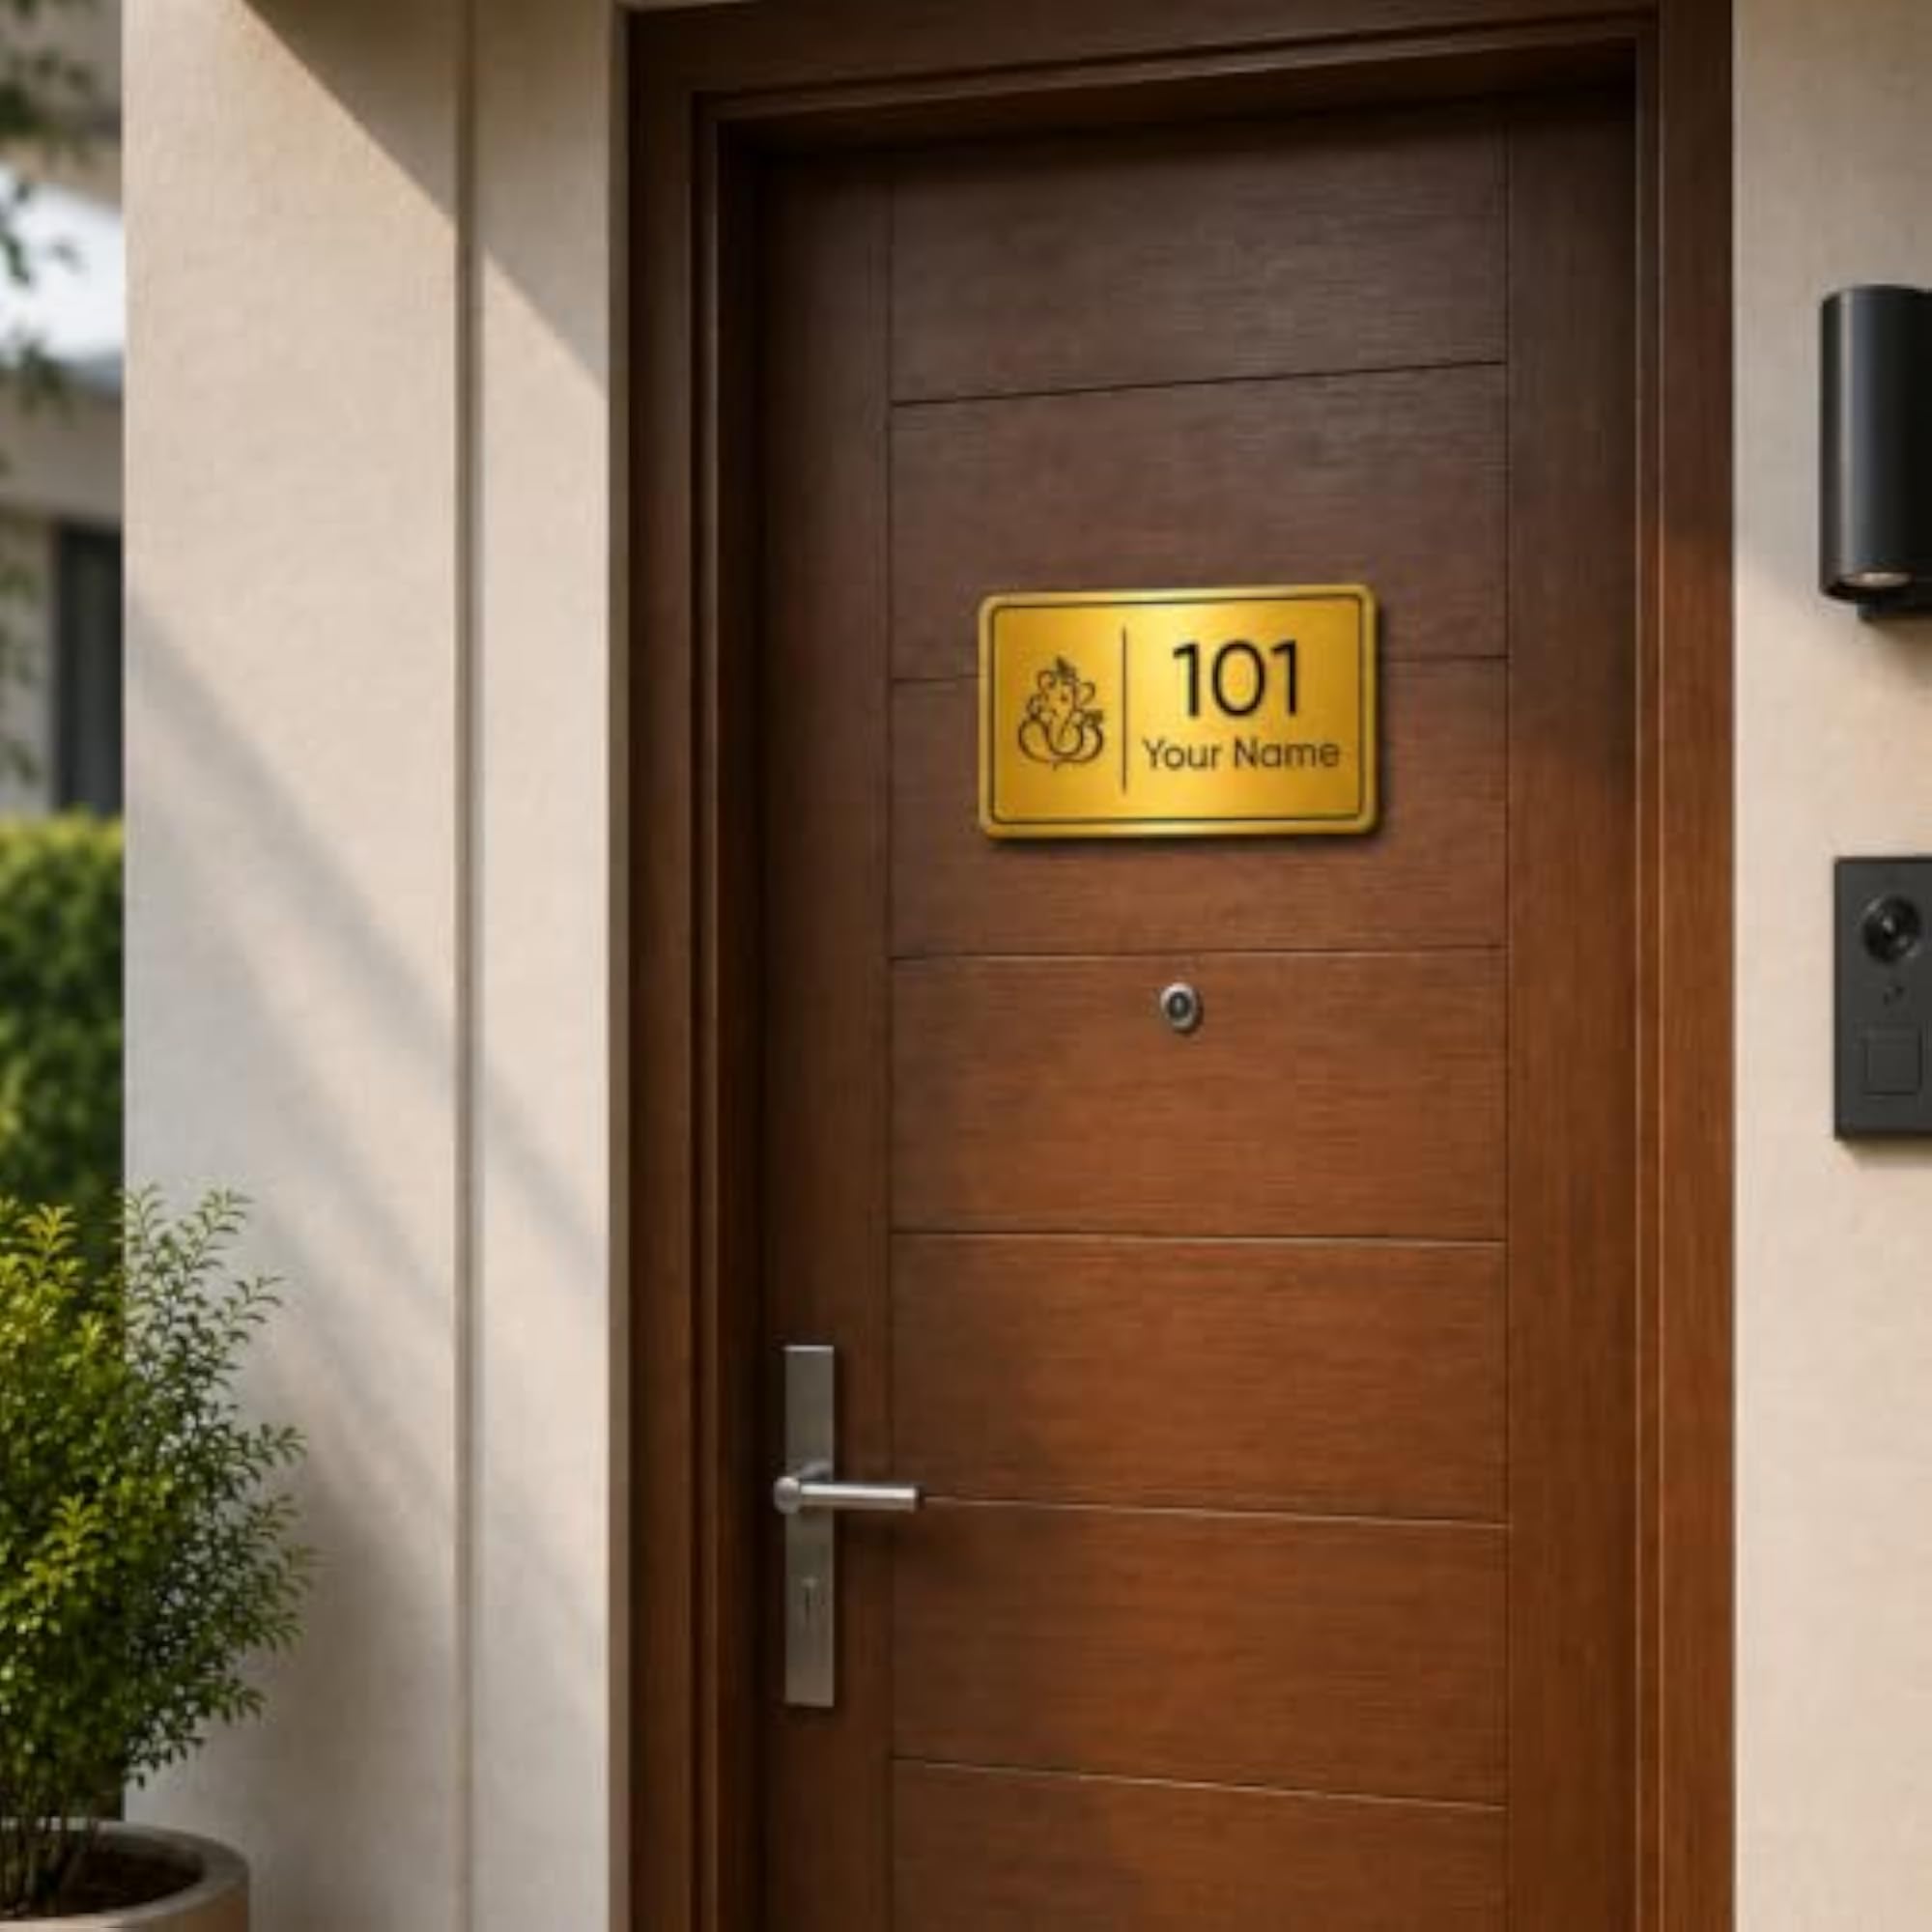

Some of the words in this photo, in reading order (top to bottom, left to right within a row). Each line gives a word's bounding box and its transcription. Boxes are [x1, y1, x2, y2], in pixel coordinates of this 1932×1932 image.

[1172, 639, 1298, 719] 101
[1144, 737, 1221, 771] Your
[1234, 737, 1341, 769] Name
